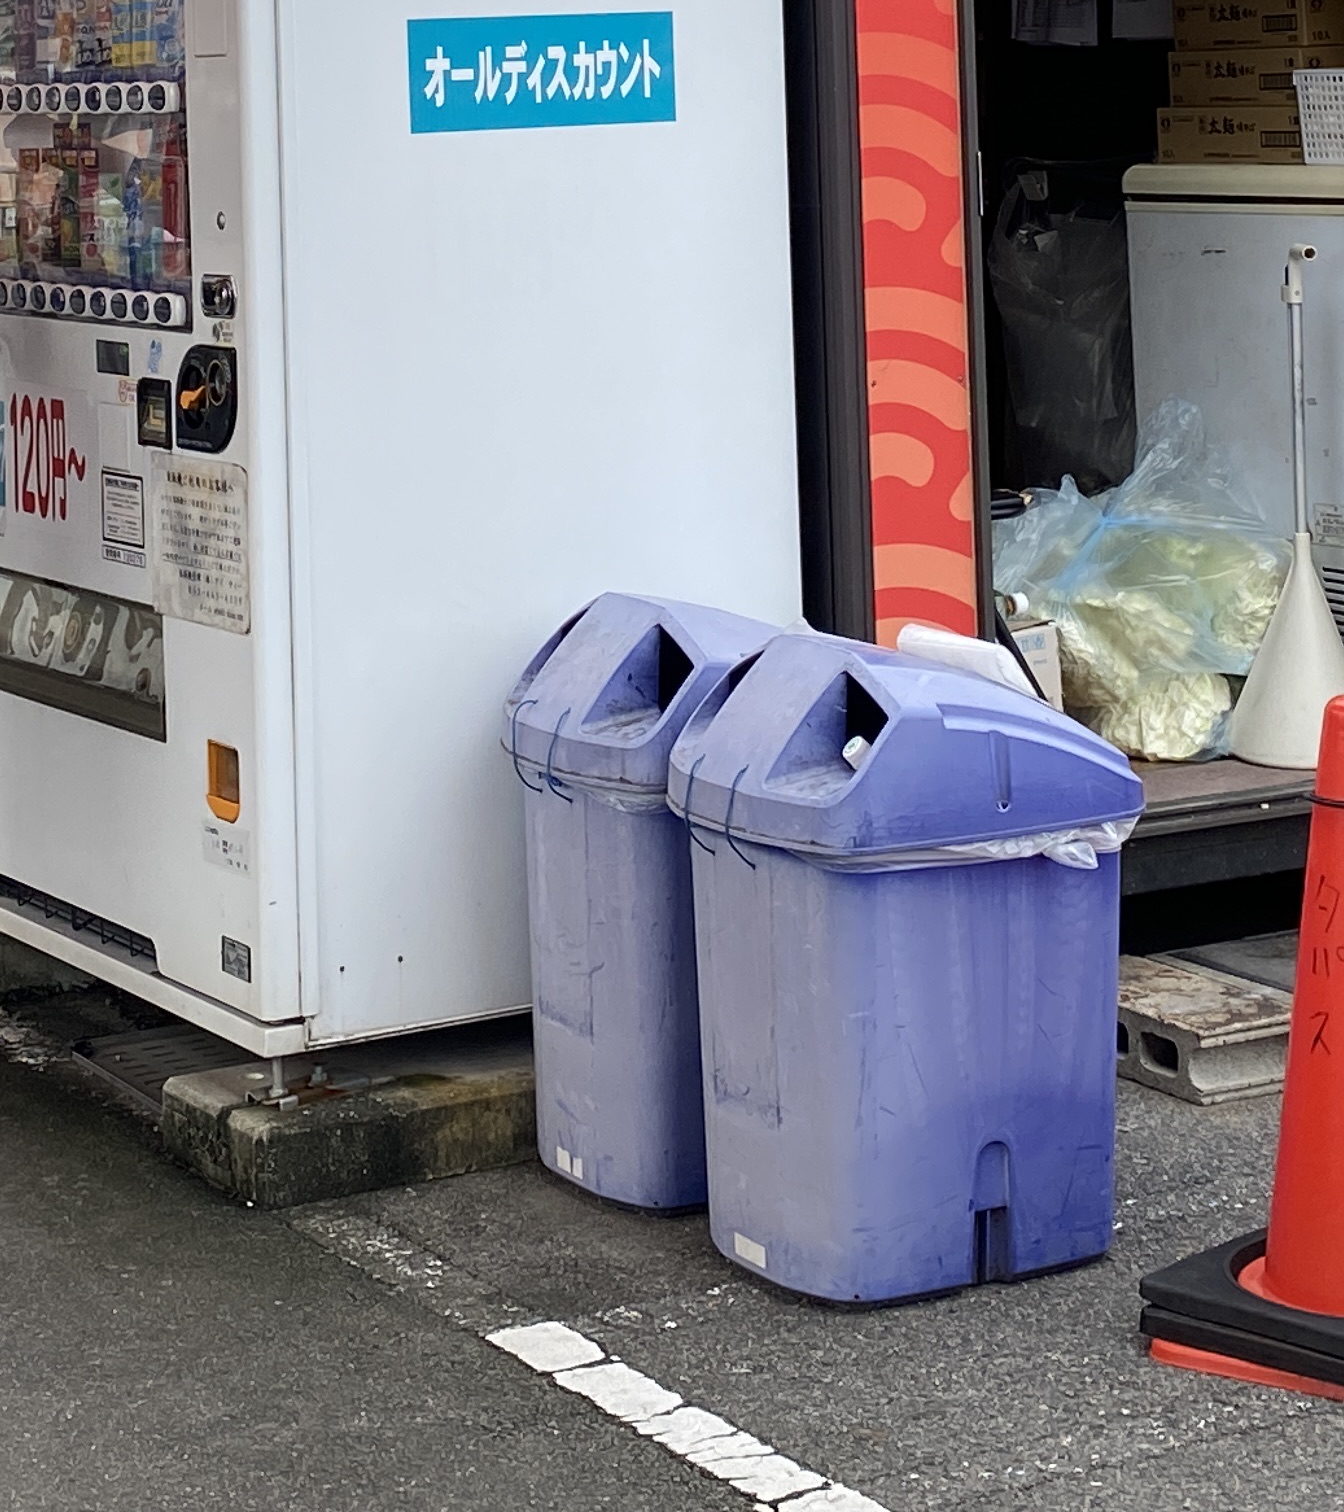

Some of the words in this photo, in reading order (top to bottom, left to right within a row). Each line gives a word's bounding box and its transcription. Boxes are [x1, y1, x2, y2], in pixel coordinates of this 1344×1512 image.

[422, 38, 661, 108] オールディスカウント
